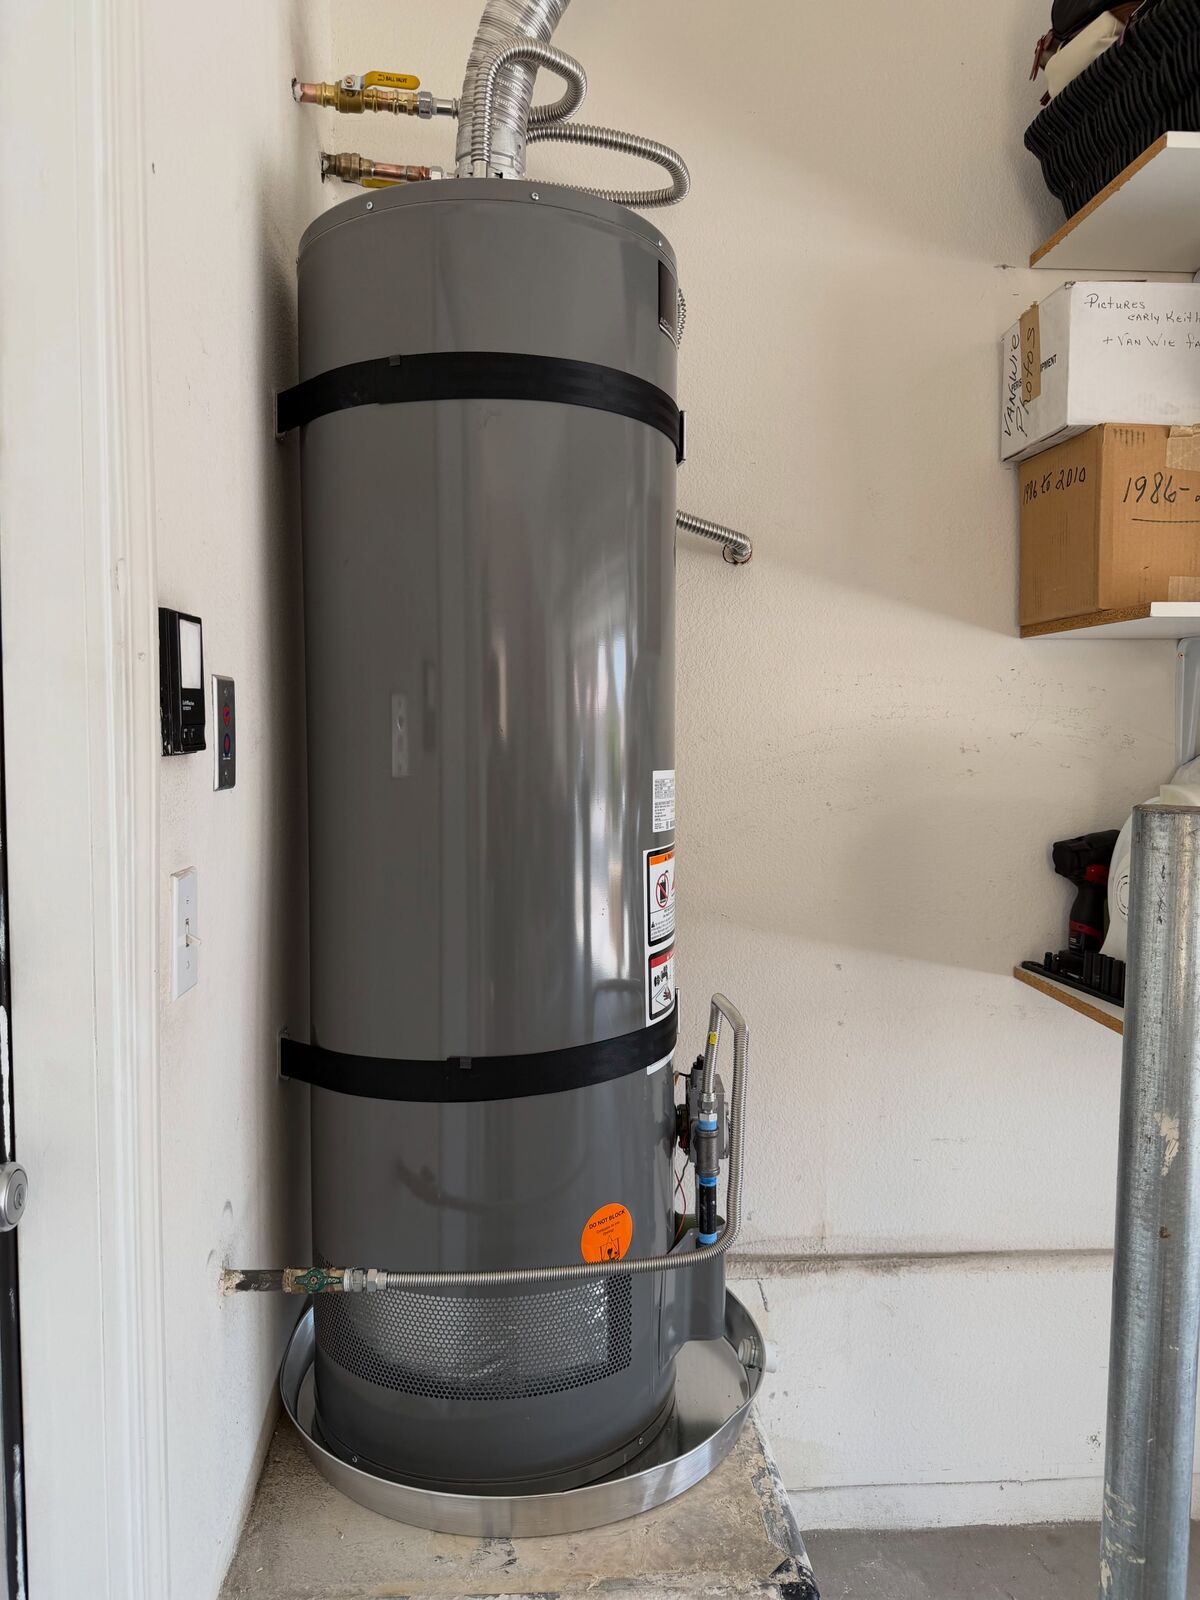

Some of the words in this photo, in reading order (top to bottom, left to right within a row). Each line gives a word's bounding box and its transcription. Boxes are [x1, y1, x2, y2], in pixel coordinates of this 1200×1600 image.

[1055, 466, 1086, 491] 2010
[589, 1222, 597, 1230] DO
[609, 1209, 625, 1220] BLOCK
